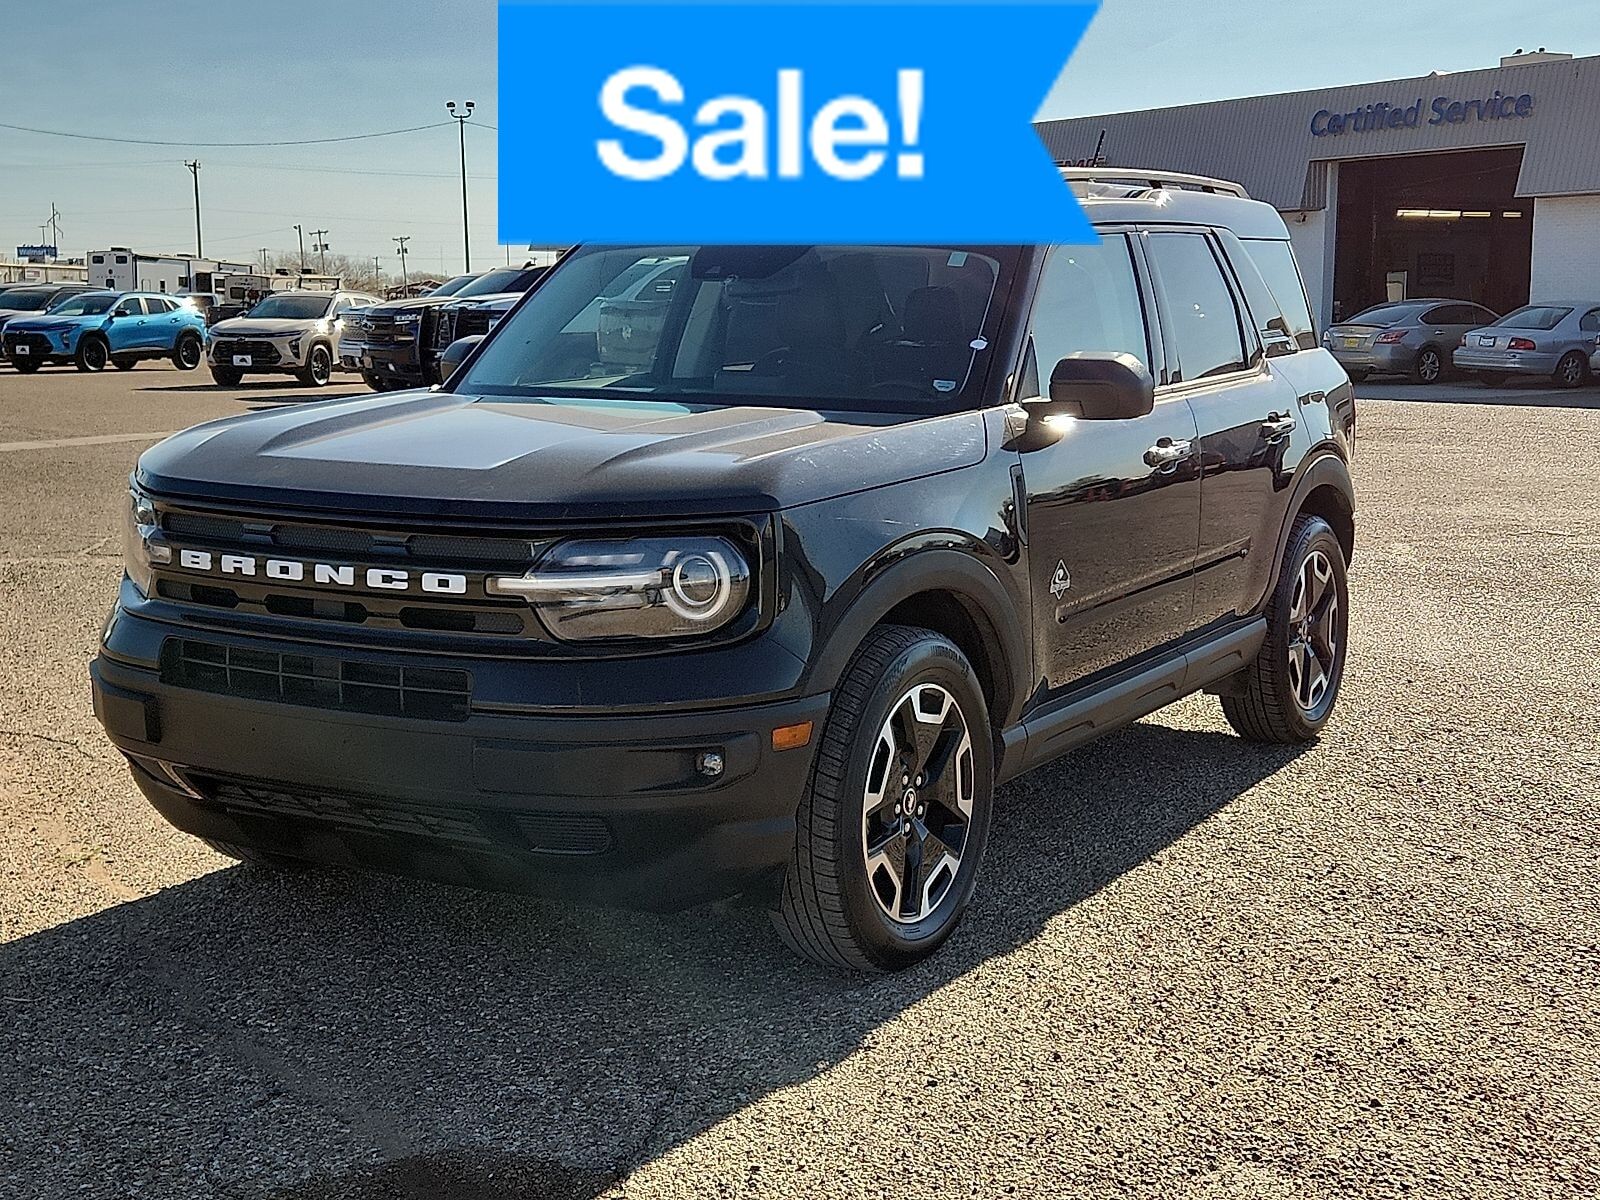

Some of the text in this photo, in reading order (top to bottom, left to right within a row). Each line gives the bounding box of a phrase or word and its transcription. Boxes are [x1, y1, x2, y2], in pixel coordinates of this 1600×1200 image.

[1310, 91, 1533, 137] Certified Service
[180, 549, 467, 594] BRONCO
